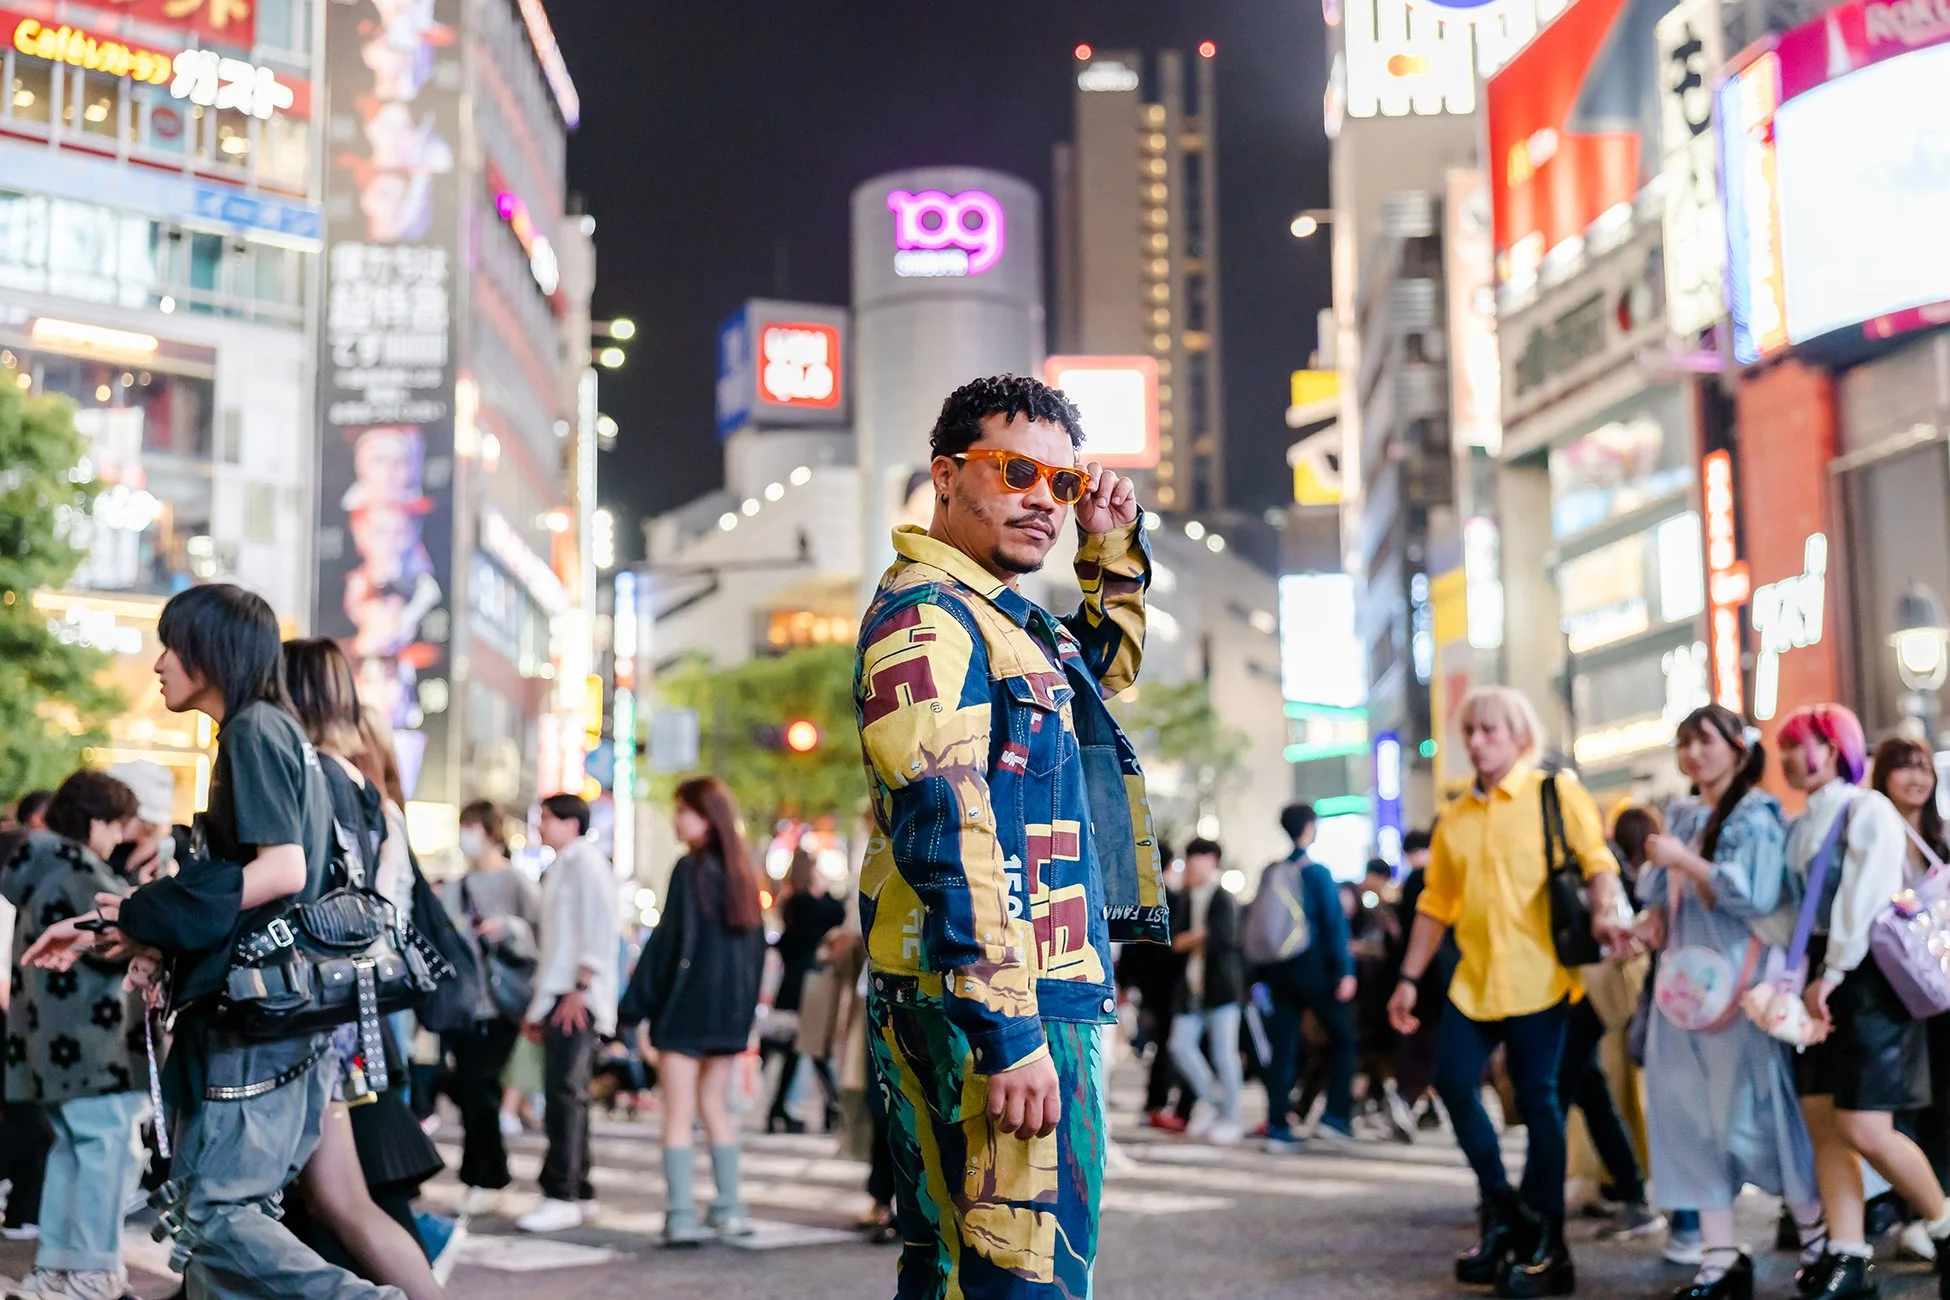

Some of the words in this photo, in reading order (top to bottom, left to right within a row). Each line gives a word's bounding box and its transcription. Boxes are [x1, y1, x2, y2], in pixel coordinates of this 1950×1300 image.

[170, 49, 293, 119] ガスト
[887, 189, 1006, 275] 109
